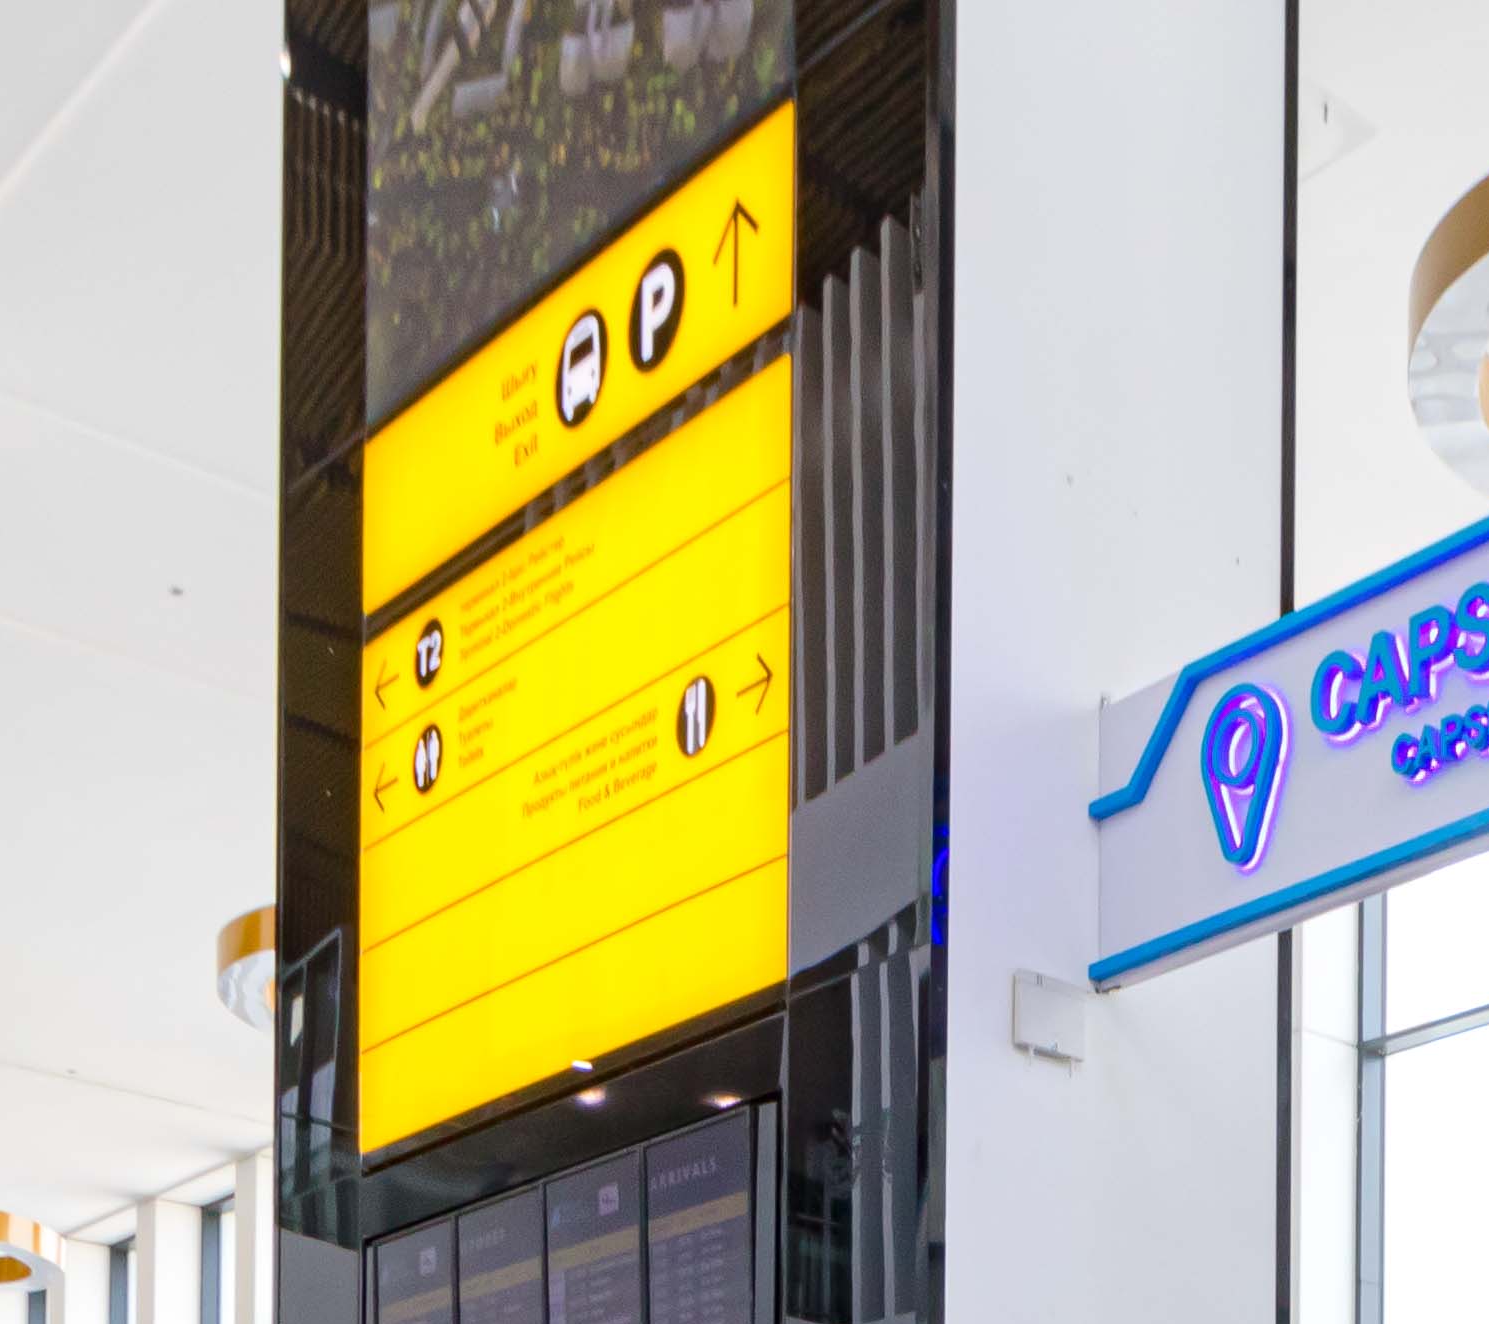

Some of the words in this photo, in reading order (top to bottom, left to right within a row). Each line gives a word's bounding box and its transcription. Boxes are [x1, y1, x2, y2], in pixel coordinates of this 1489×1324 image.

[495, 401, 537, 446] Выход
[514, 433, 537, 465] Exit
[417, 629, 442, 677] T2
[578, 783, 601, 812] Food
[613, 761, 658, 793] Beverage
